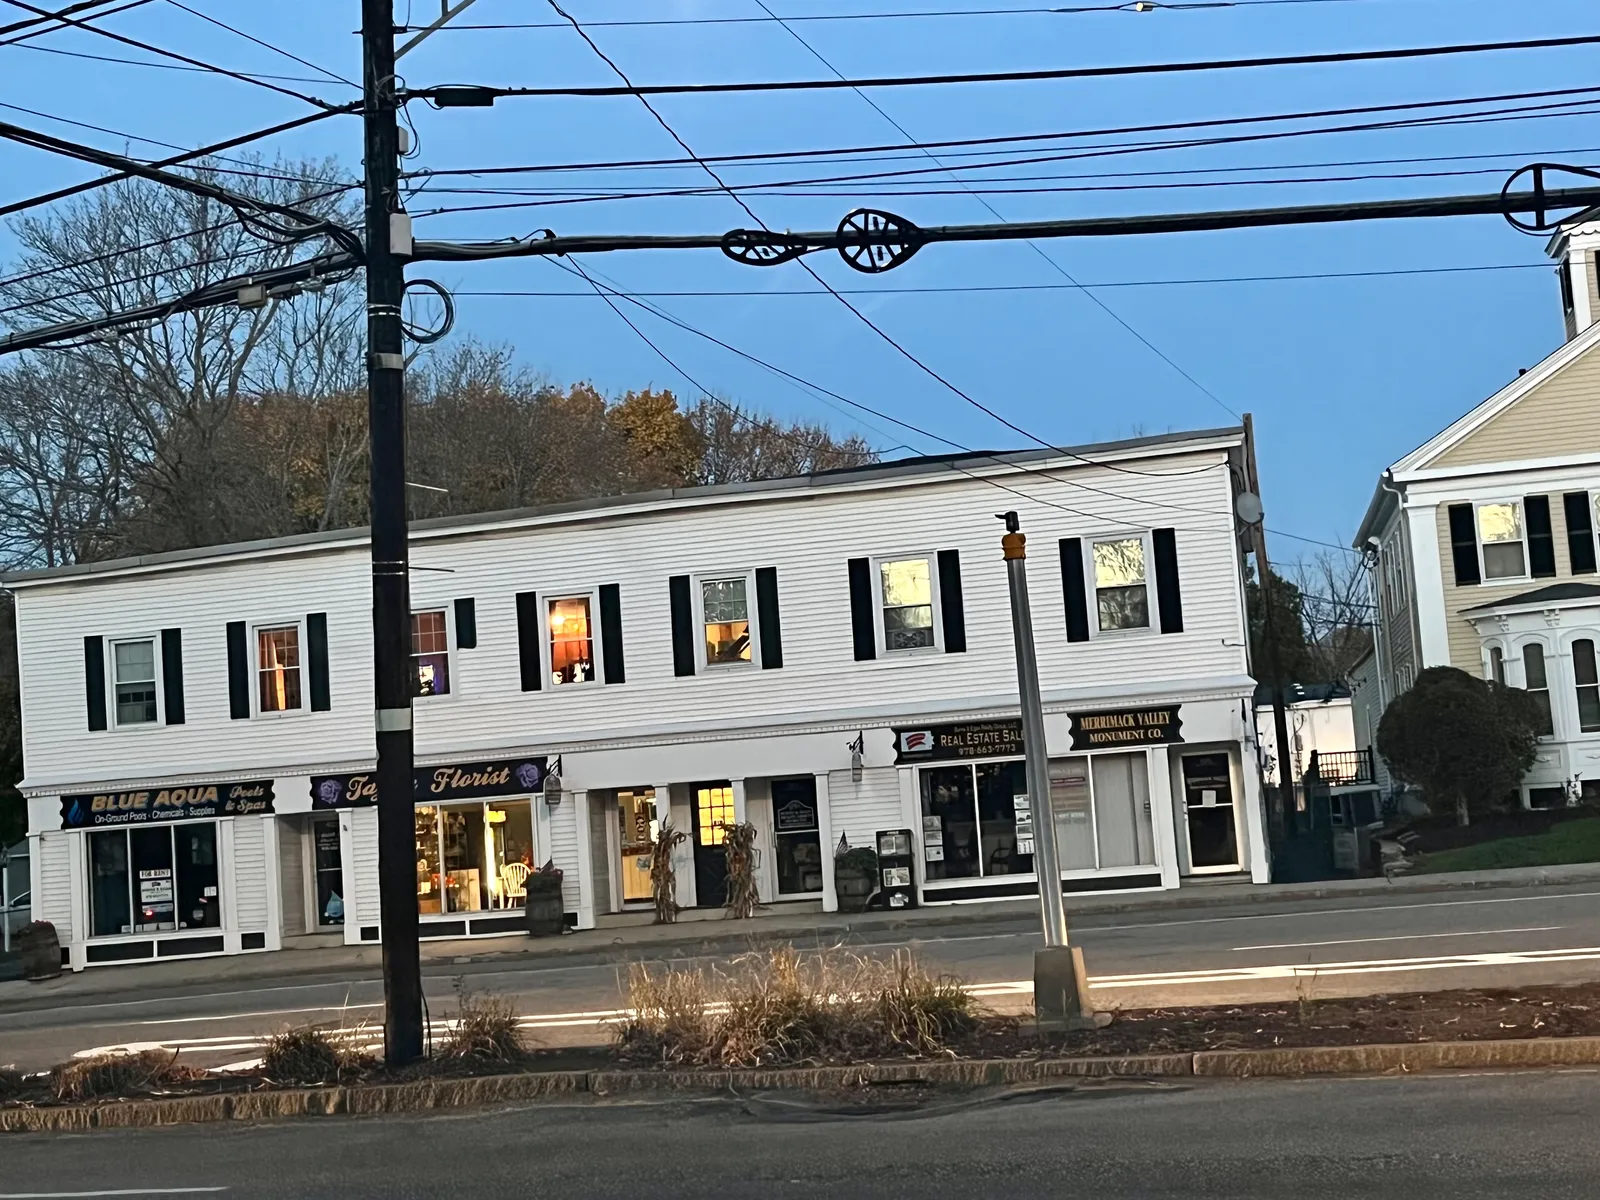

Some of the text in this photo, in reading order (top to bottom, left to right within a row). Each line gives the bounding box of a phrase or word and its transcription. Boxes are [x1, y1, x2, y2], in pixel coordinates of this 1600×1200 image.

[1080, 711, 1171, 730] MERRIMACK VALLEY
[940, 734, 964, 746] REAL
[966, 732, 1000, 745] ESTATE
[1089, 728, 1164, 743] MONUMENT CO.
[430, 766, 511, 793] Florist
[91, 786, 218, 812] BLUE AQUA
[229, 785, 264, 798] Pools
[237, 798, 266, 813] Spas
[94, 806, 215, 824] On-Ground Pools Chemicals Supplies
[154, 869, 169, 877] RENT
